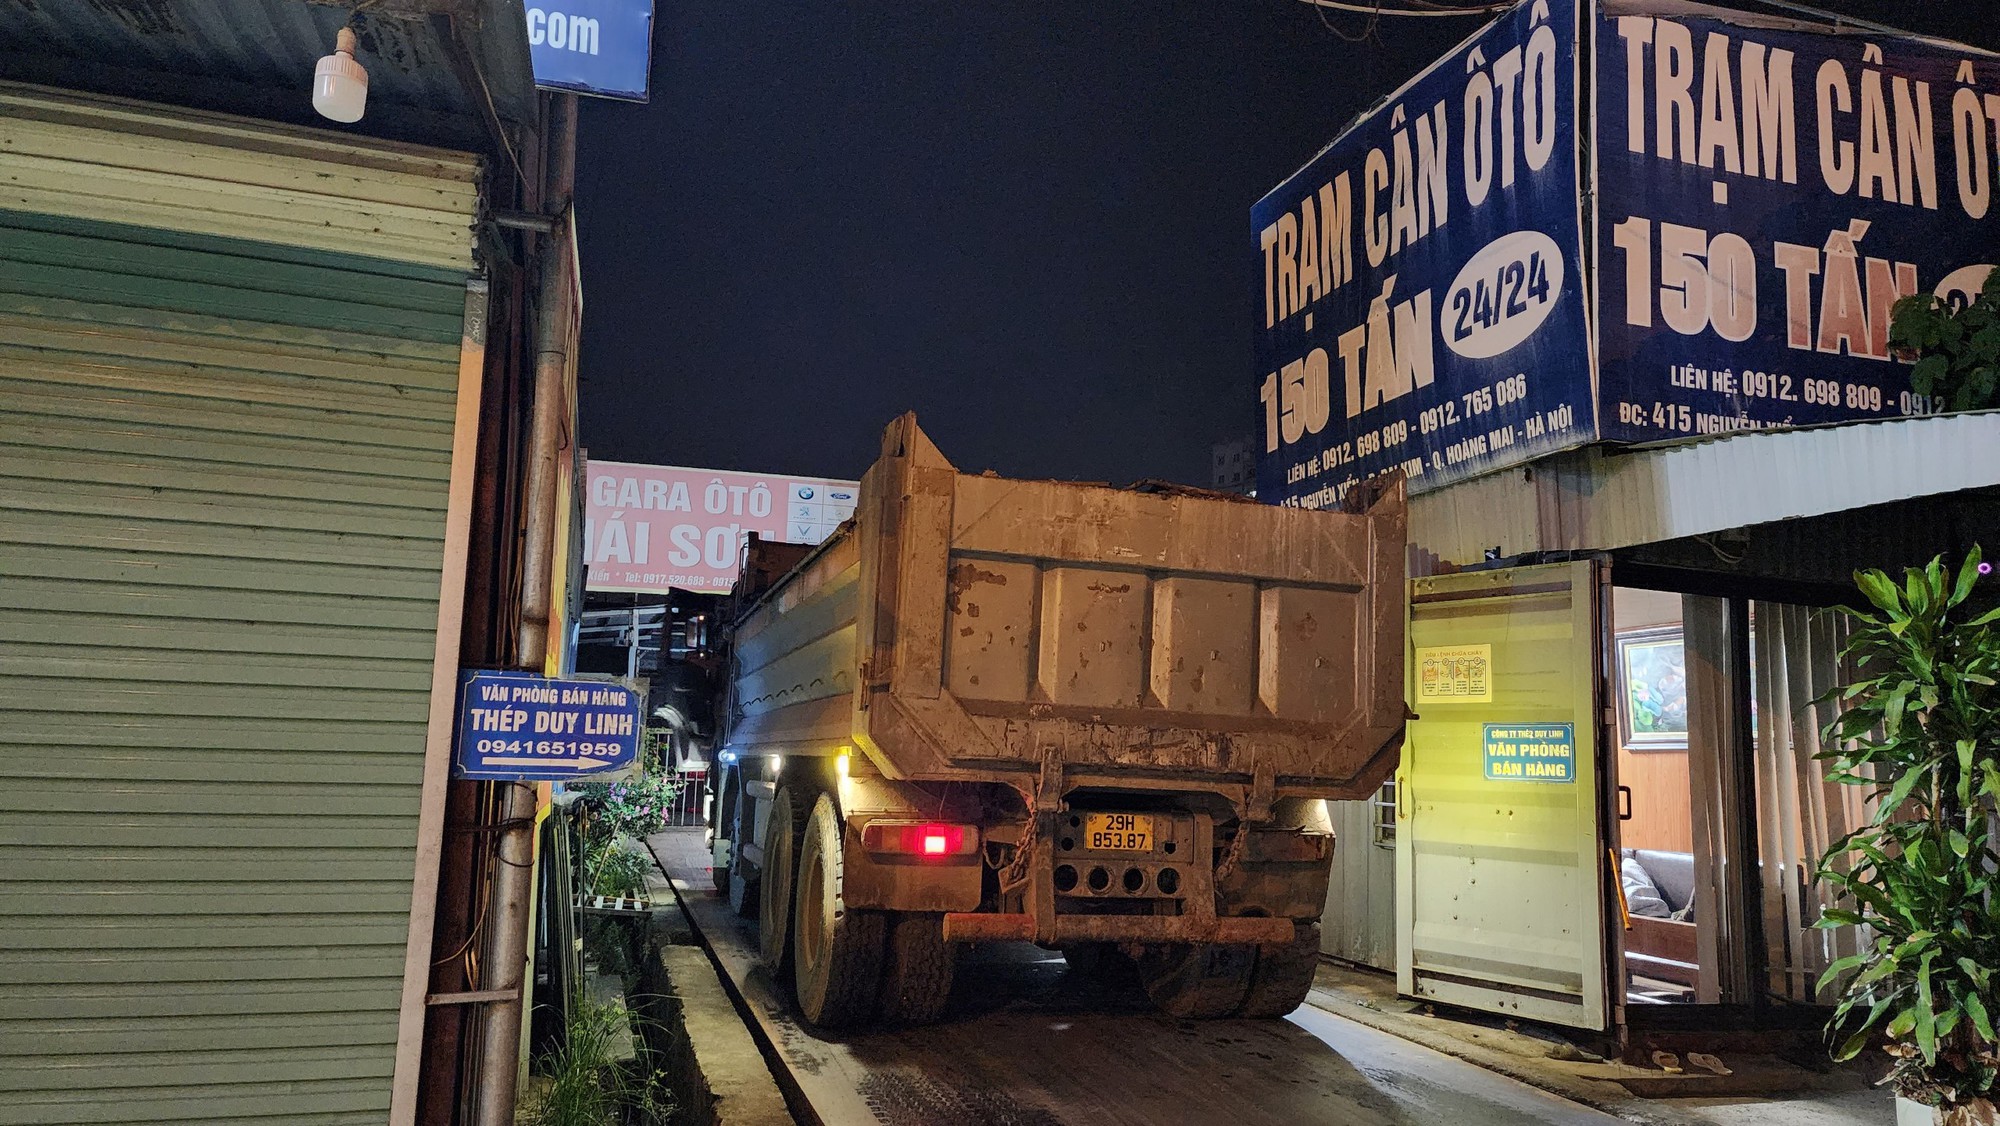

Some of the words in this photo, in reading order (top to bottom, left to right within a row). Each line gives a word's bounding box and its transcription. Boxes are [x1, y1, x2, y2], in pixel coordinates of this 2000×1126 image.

[526, 8, 600, 55] com
[1617, 15, 1798, 205] TRẠM
[1816, 43, 1938, 210] CÂN
[1261, 170, 1353, 331] TRẠM
[1364, 99, 1448, 268] CÂN
[1463, 0, 1556, 206] ÔTÔ
[1453, 250, 1550, 343] 24/24
[1613, 216, 1757, 342] 150
[1774, 218, 1920, 364] TẤN
[1261, 348, 1330, 454] 150
[1338, 273, 1435, 419] TẤN
[1670, 362, 1708, 391] LIÊN
[1742, 370, 1798, 402] 0912.
[1803, 377, 1840, 407] 698
[1846, 384, 1882, 412] 809
[1287, 462, 1306, 485] LIÊN
[1322, 442, 1355, 471] 0912.
[1357, 434, 1381, 457] 698
[1383, 420, 1408, 447] 809
[1419, 401, 1461, 434] 0912.
[1463, 389, 1492, 419] 765
[1496, 373, 1527, 406] 086
[1446, 437, 1487, 463] HOÀNG
[1489, 425, 1514, 449] MAI
[1526, 411, 1546, 438] HÀ
[1548, 403, 1573, 434] NỘI
[1619, 401, 1648, 427] ĐC:
[1652, 401, 1692, 432] 415
[592, 475, 692, 512] GARA
[704, 478, 773, 518] ÔTÔ
[667, 522, 775, 570] SƠ
[482, 684, 509, 702] VĂN
[513, 684, 558, 704] PHÒNG
[562, 687, 588, 705] BÁN
[592, 688, 627, 706] HÀNG
[471, 705, 528, 732] THÉP
[534, 711, 580, 734] DUY
[585, 713, 633, 736] LINH
[477, 739, 621, 756] 0941651959
[1488, 742, 1516, 756] VĂN
[1520, 741, 1569, 757] PHÒNG
[1493, 761, 1522, 775] BÁN
[1526, 761, 1565, 776] HÀNG
[1093, 832, 1146, 848] 853.87
[1106, 815, 1135, 831] 29H
